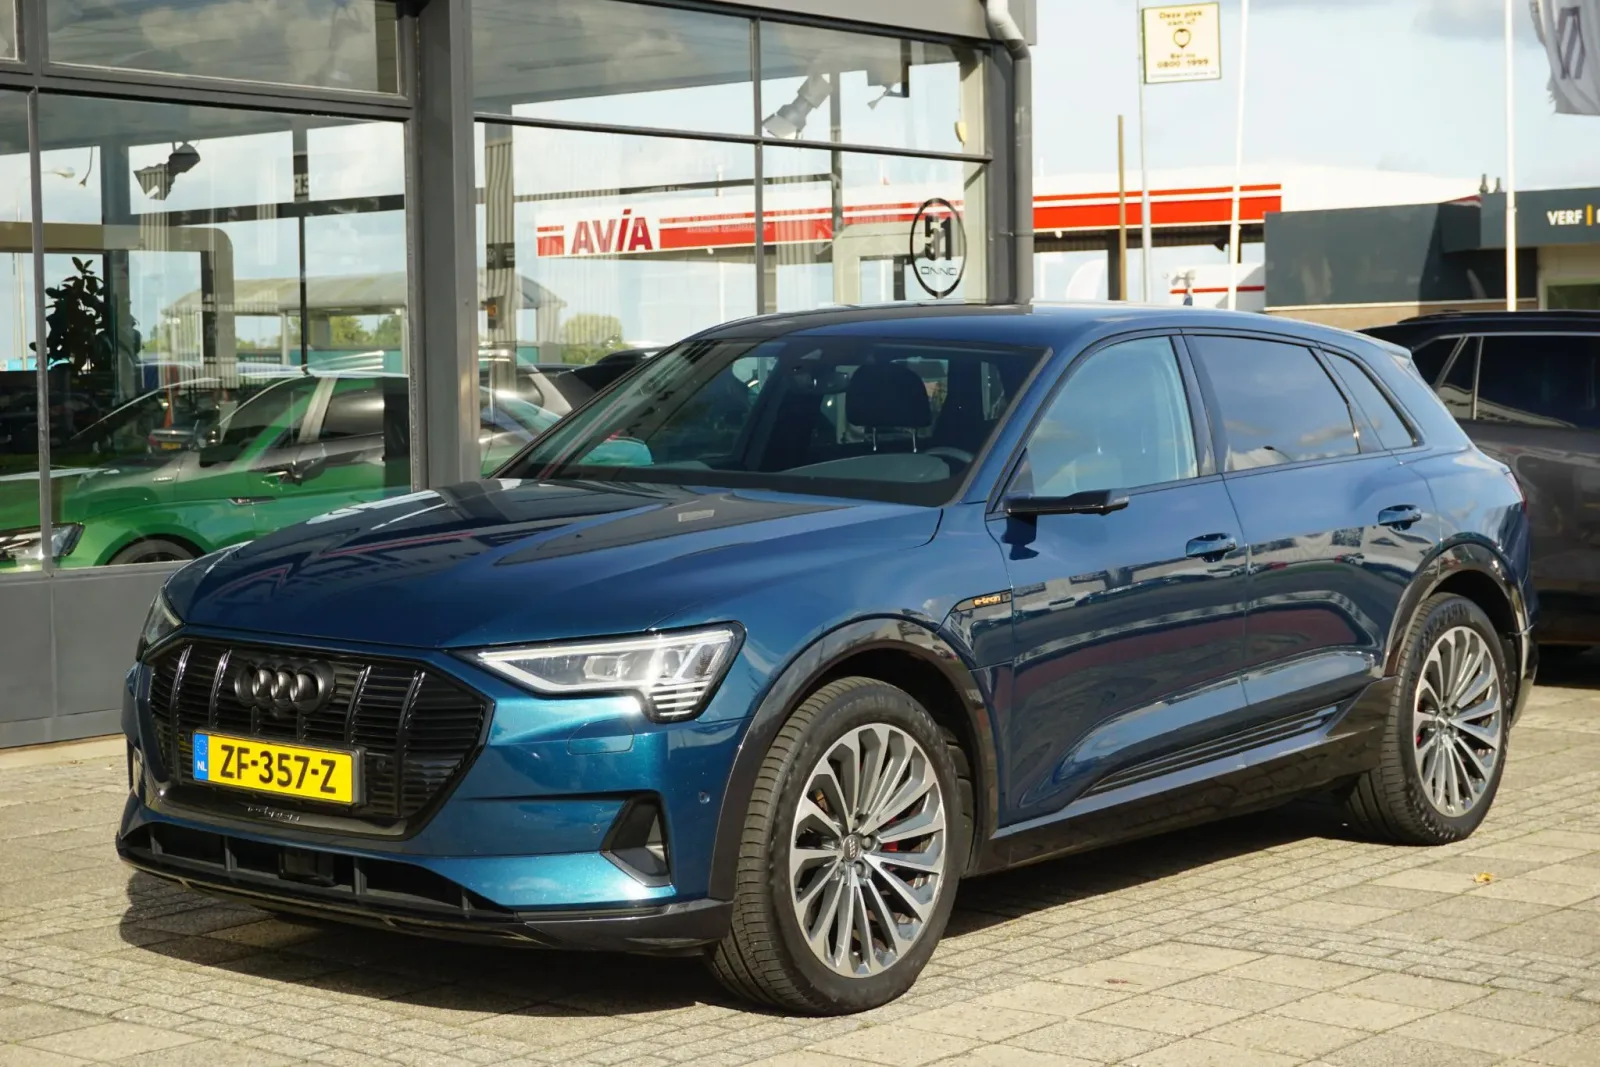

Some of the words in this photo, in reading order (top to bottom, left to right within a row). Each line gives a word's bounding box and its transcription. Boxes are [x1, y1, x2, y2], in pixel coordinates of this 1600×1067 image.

[1546, 209, 1583, 226] VERF
[924, 215, 952, 262] 51
[197, 760, 208, 772] NL
[220, 744, 337, 794] ZF-357-Z
